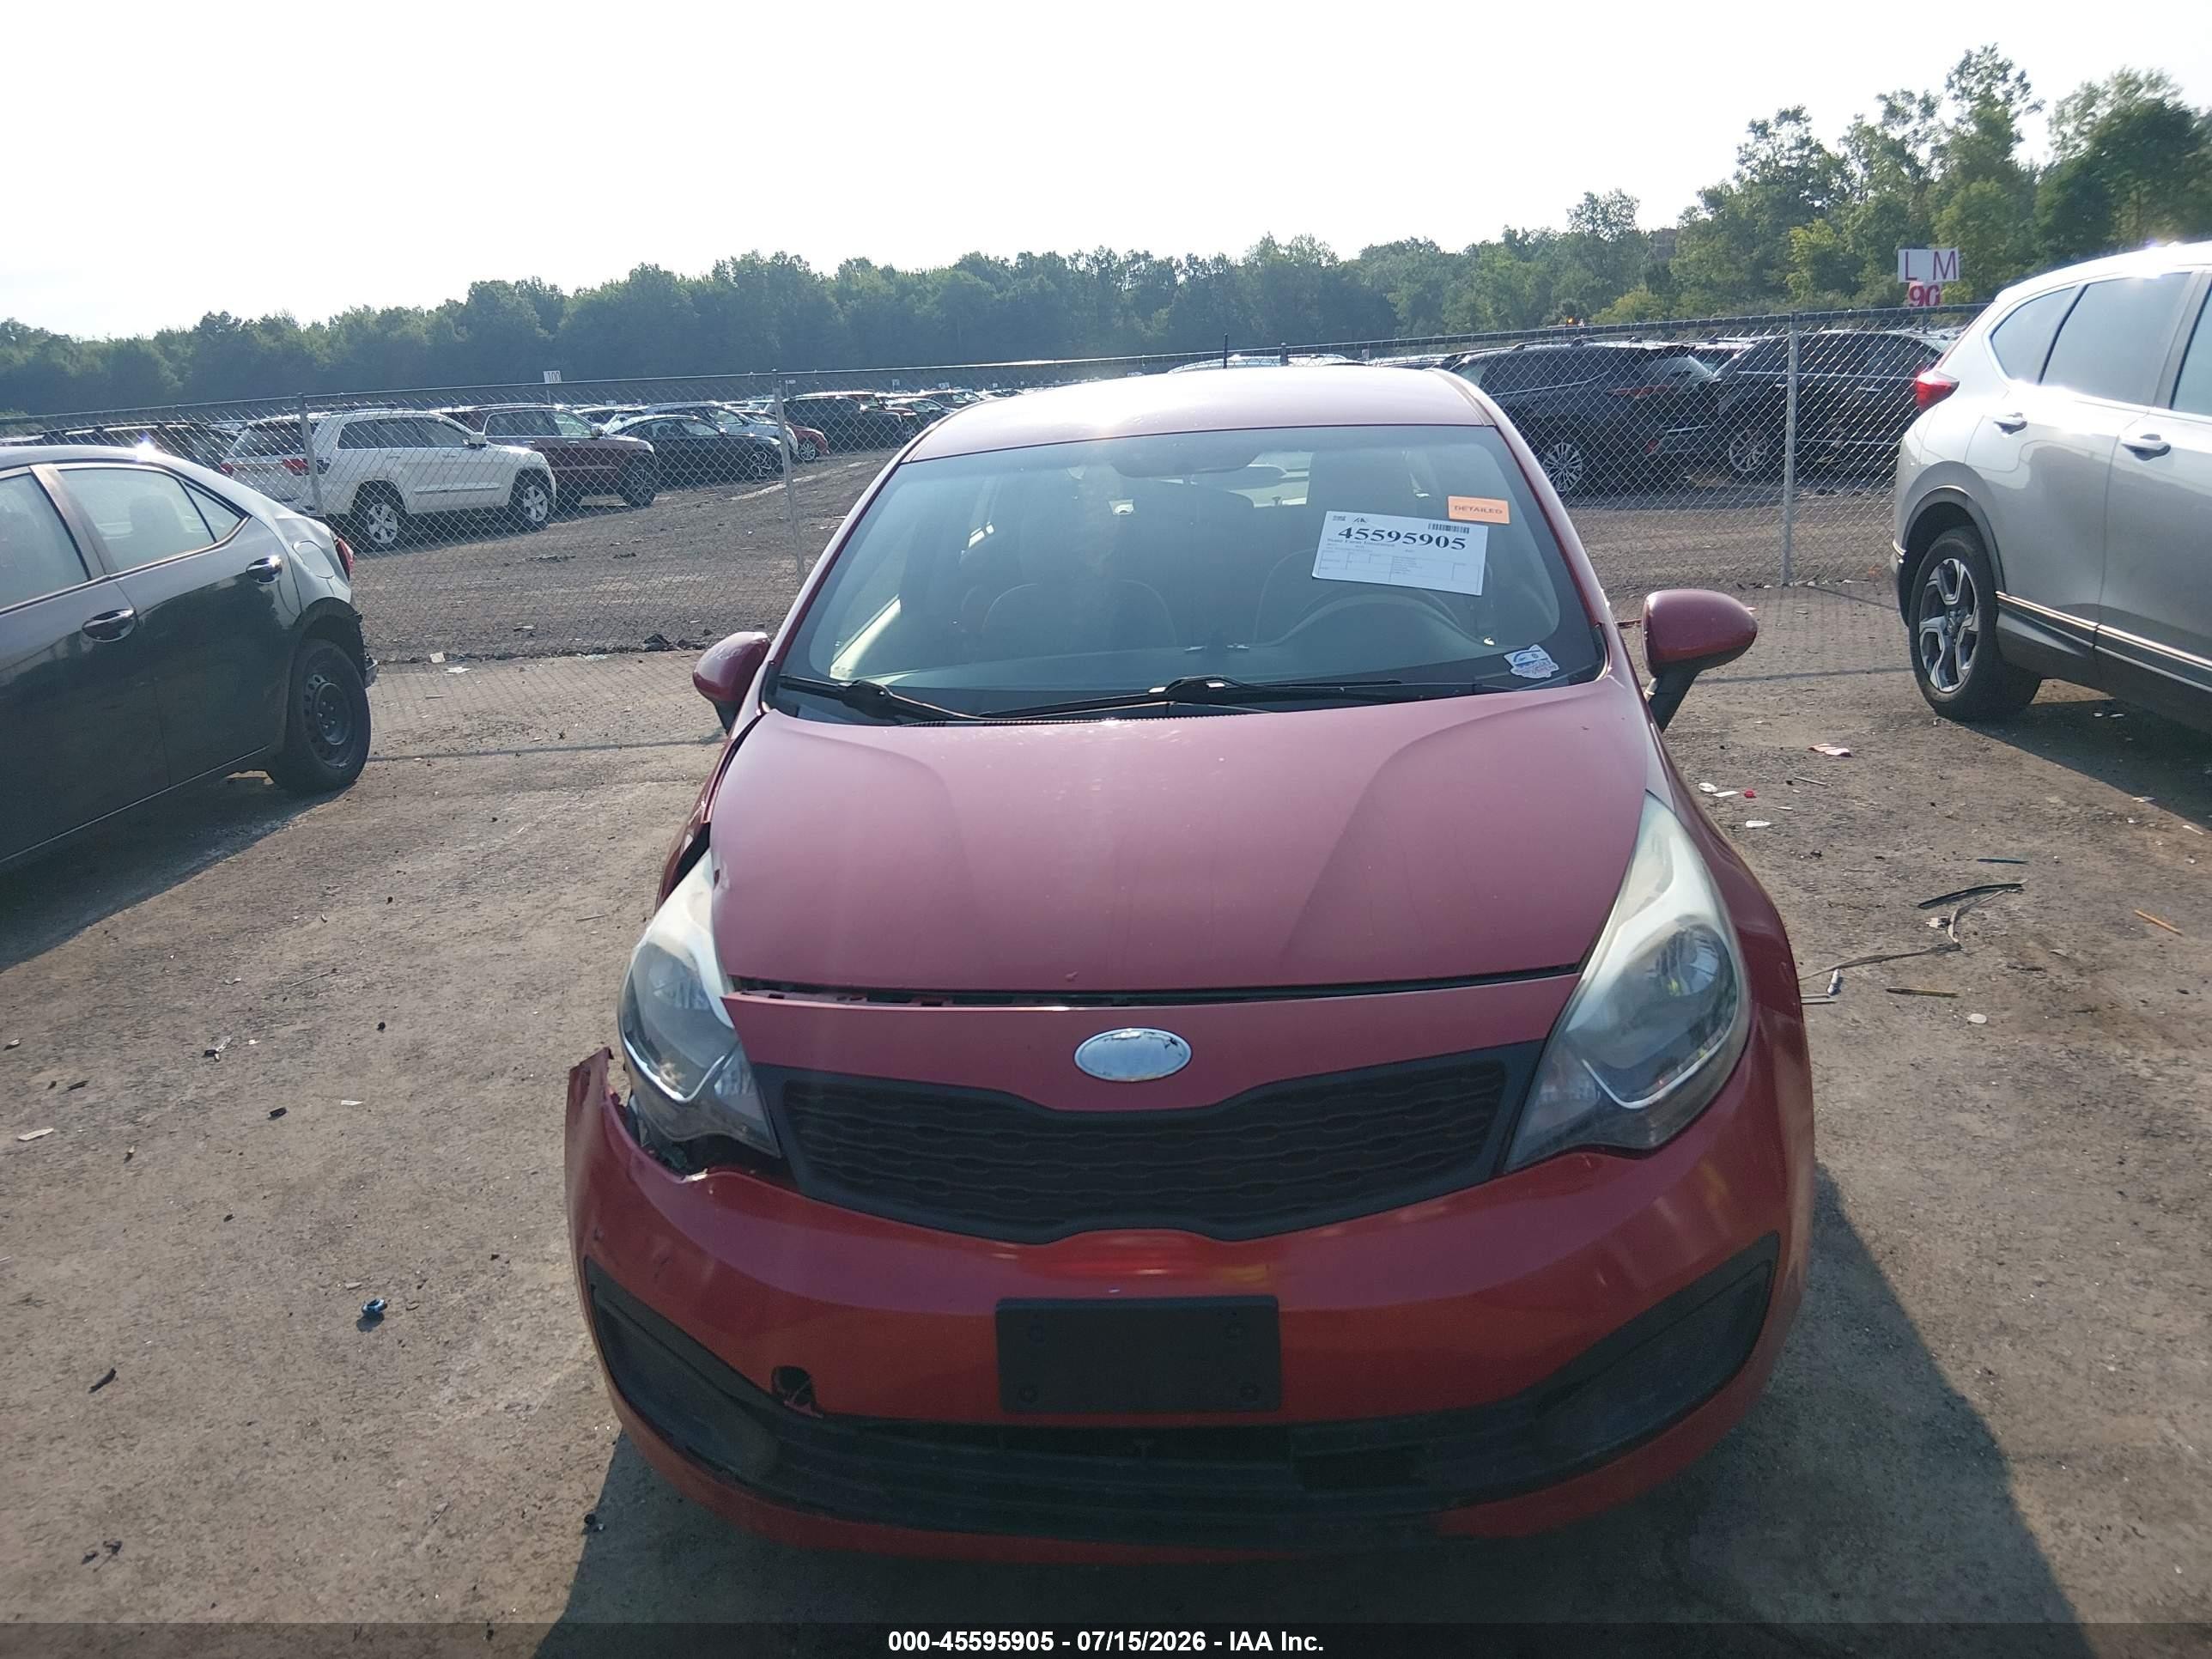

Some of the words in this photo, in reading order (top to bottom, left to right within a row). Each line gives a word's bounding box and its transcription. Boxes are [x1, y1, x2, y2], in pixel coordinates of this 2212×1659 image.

[1905, 251, 1917, 281] L
[1932, 251, 1957, 281] M
[1908, 284, 1941, 307] 90
[1454, 505, 1504, 515] DETAILED
[1338, 526, 1468, 550] 45595905
